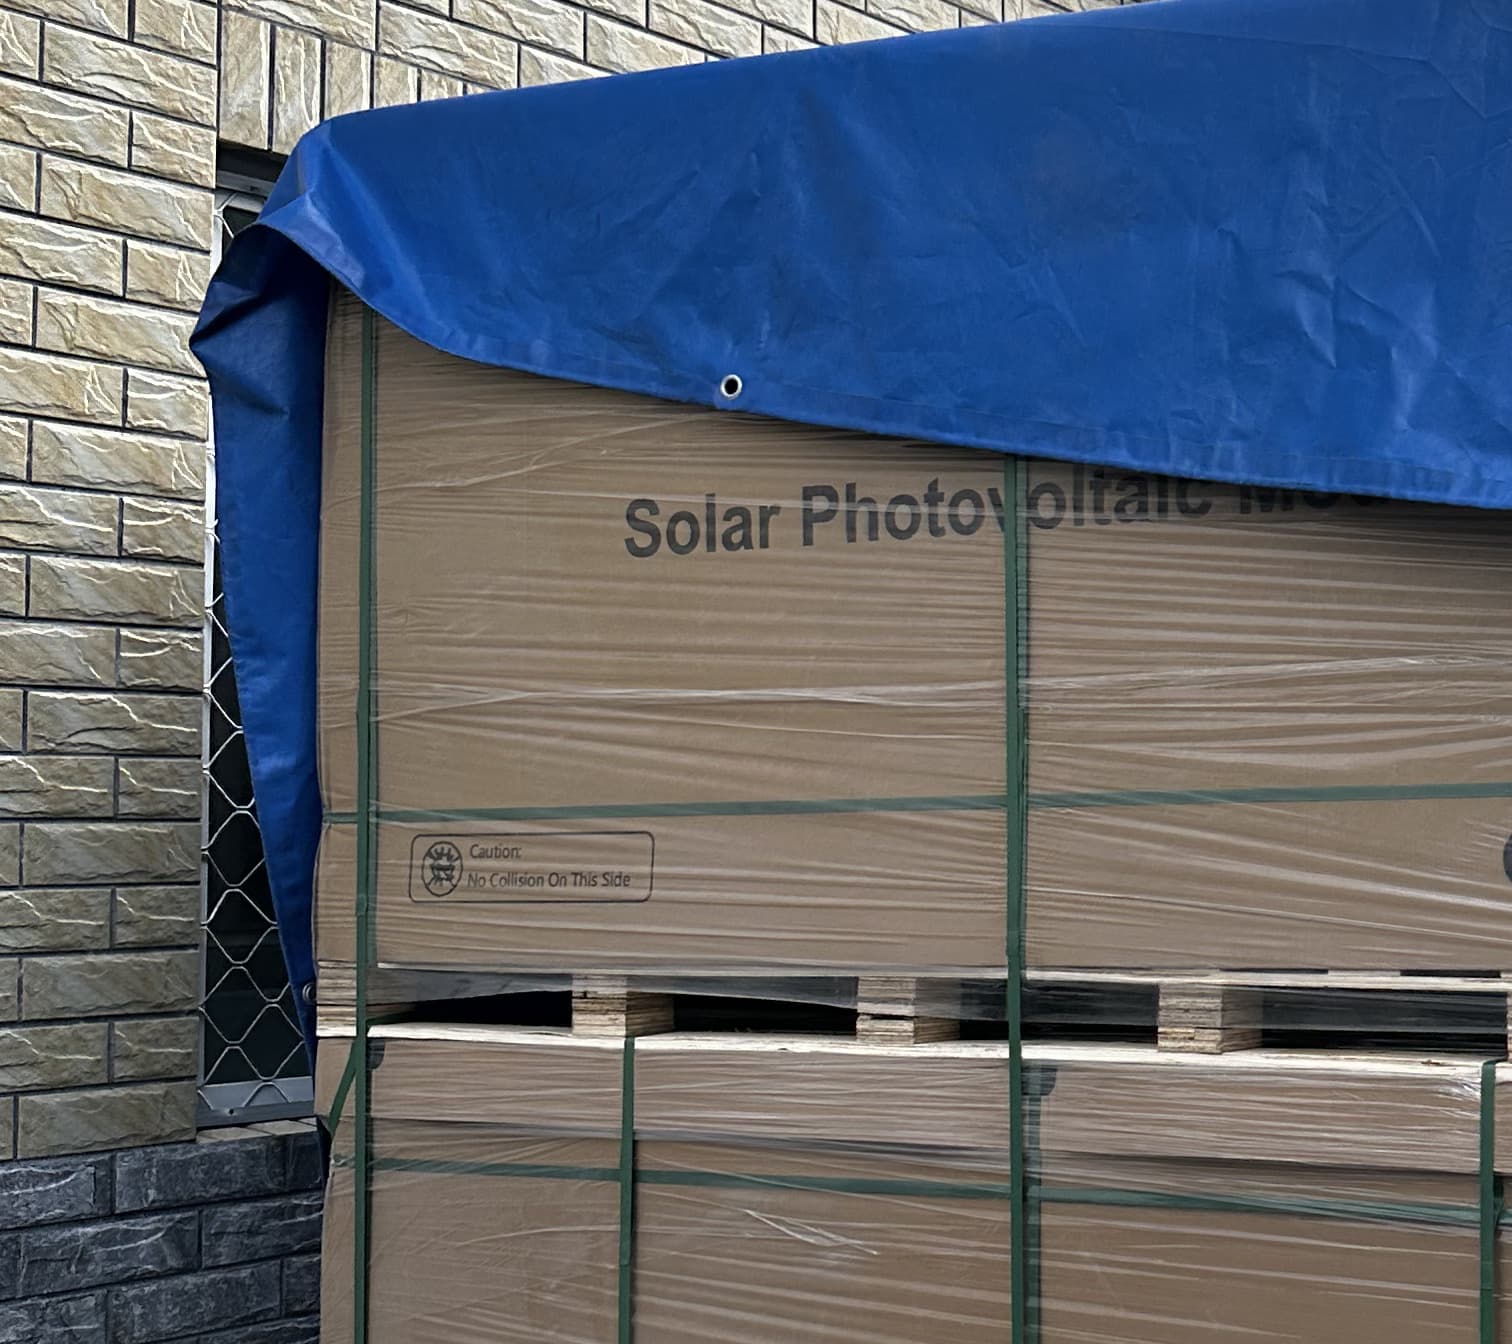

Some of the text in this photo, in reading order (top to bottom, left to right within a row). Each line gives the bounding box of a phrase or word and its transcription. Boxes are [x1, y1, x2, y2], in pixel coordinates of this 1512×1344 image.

[624, 498, 777, 559] Solar
[800, 464, 1214, 548] Photovoltaic
[469, 843, 522, 860] Caution:
[467, 871, 631, 889] No Collision On This Side
